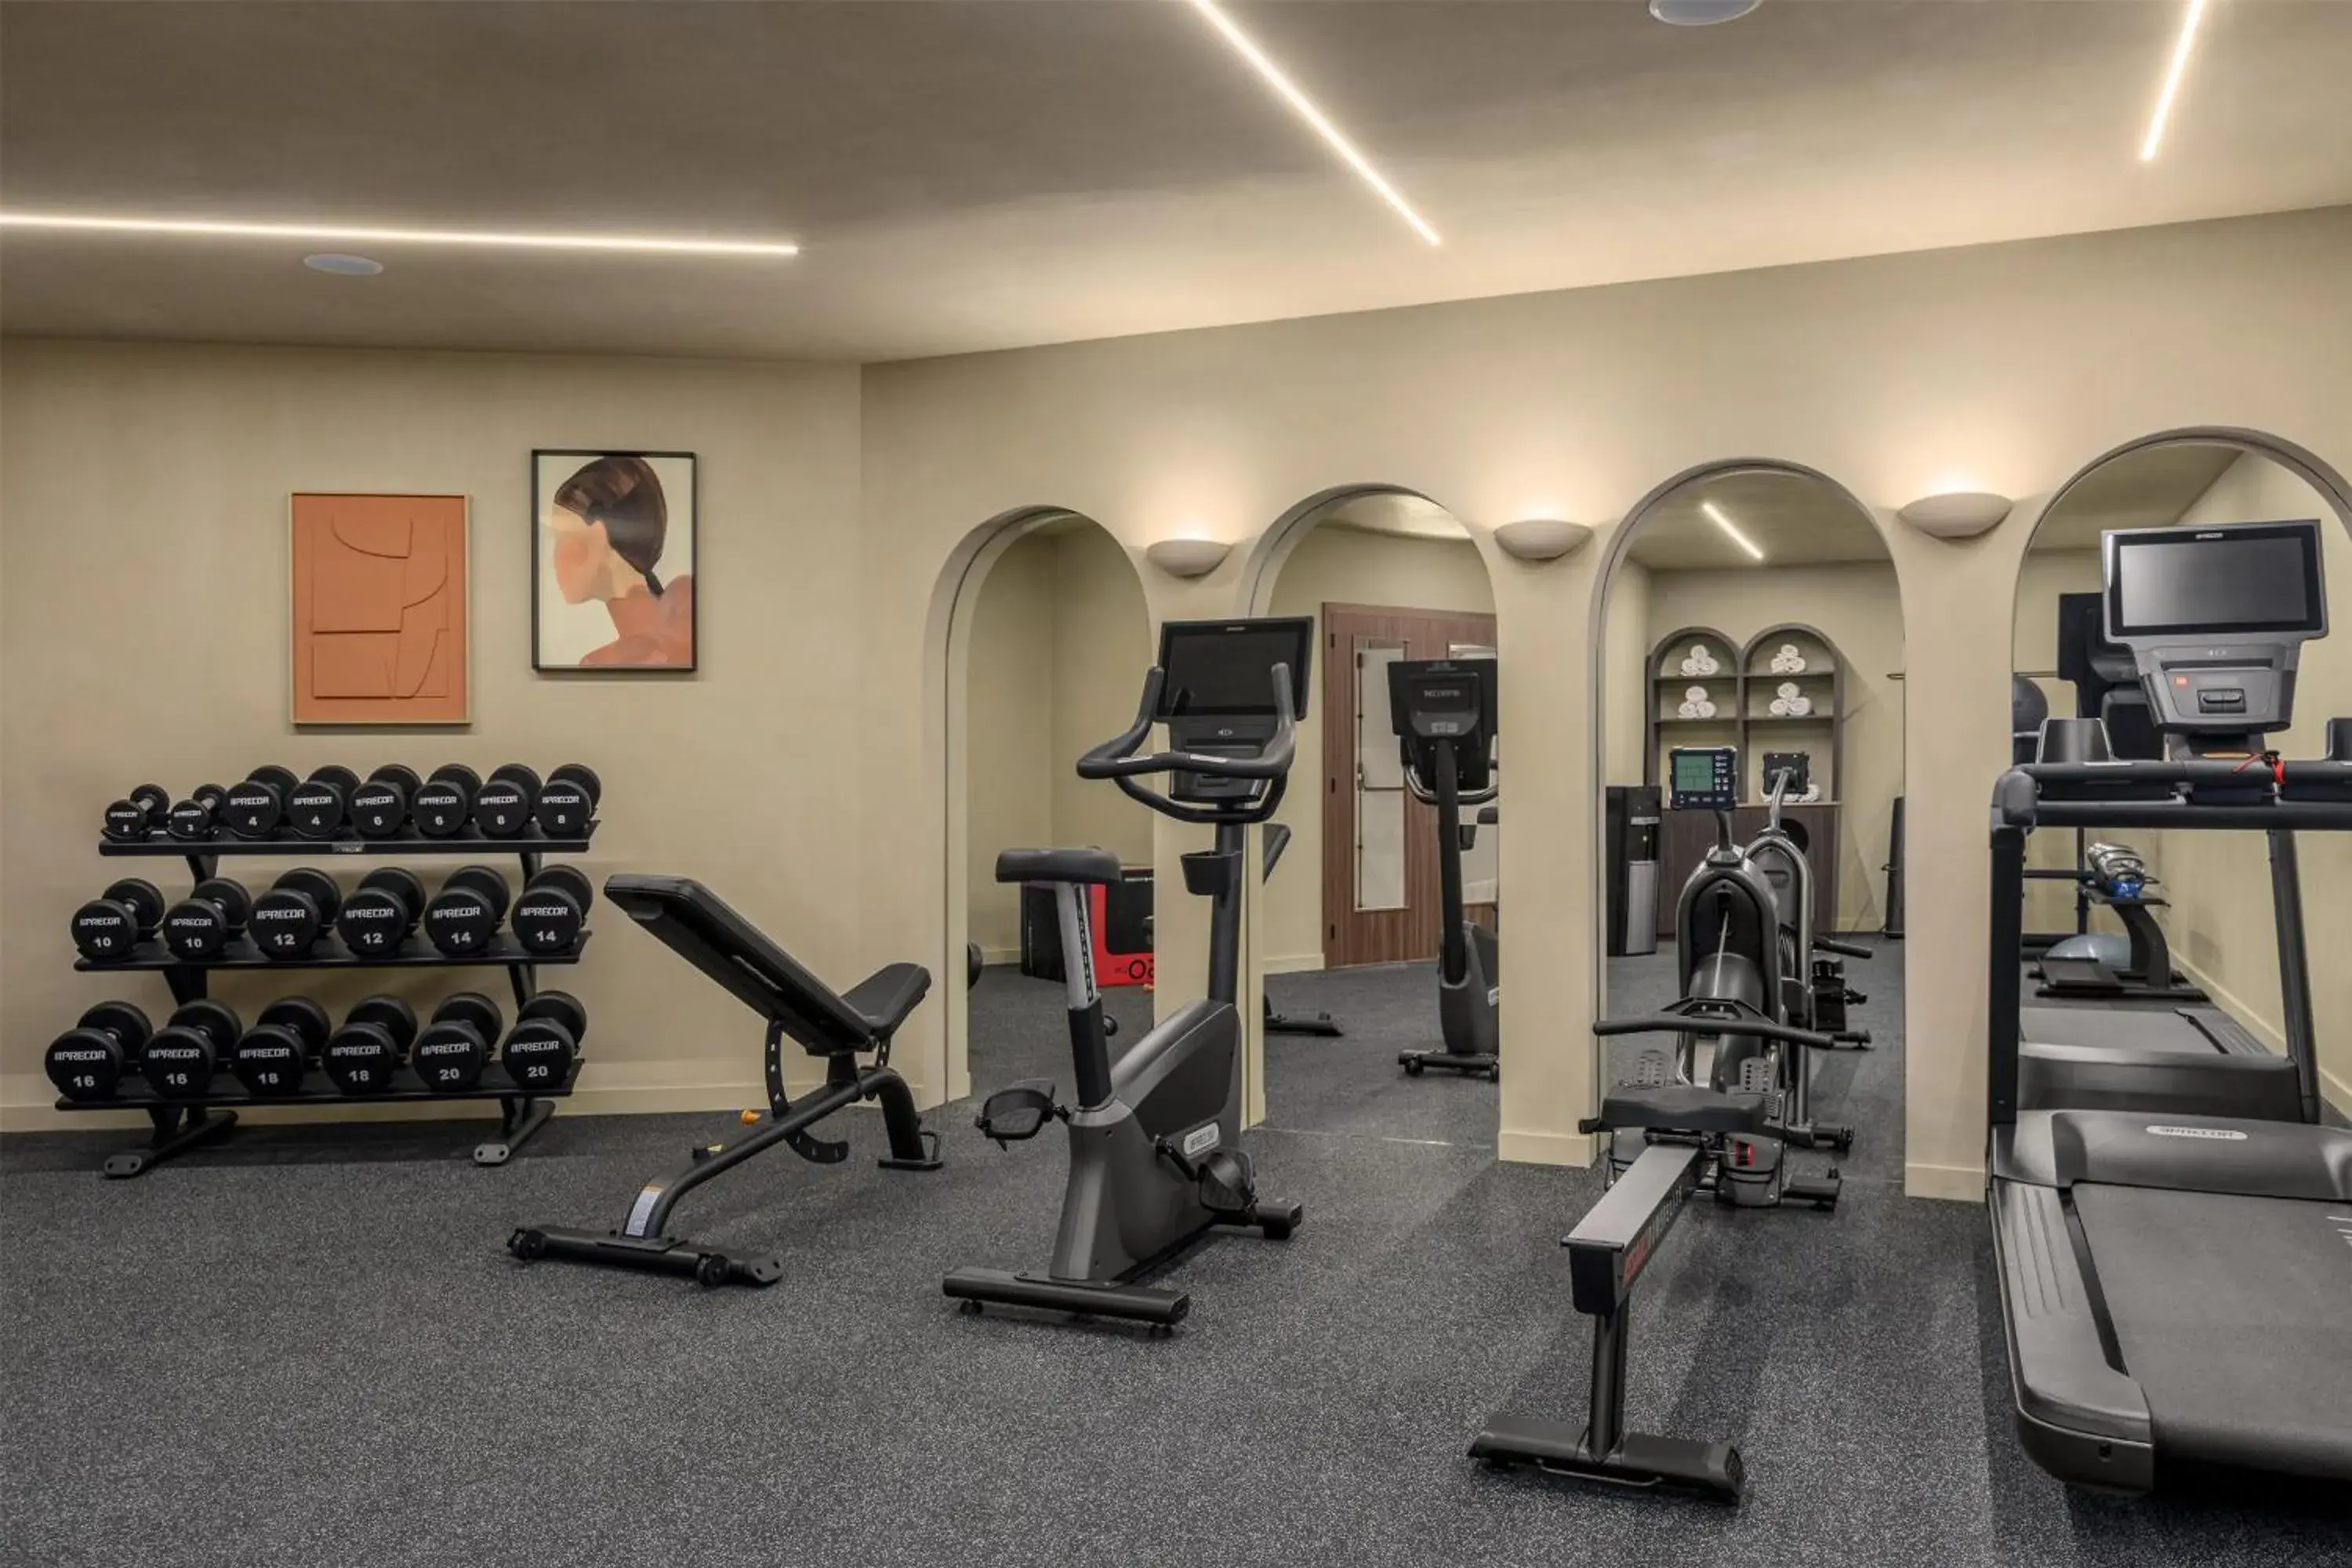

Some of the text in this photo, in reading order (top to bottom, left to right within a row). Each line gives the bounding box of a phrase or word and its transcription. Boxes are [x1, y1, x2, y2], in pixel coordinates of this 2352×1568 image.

[249, 816, 258, 826] 4
[311, 815, 321, 826] 4
[373, 815, 383, 826] 6
[434, 815, 444, 826] 6
[557, 815, 566, 824] 8
[263, 909, 306, 920] PRECOR
[352, 907, 394, 919] PRECOR
[439, 906, 481, 919] PRECOR
[526, 906, 568, 916] PRECOR
[85, 916, 121, 926] PRECOR
[176, 918, 212, 927] PRECOR
[274, 933, 296, 946] 12
[363, 932, 383, 944] 12
[451, 931, 471, 944] 14
[536, 930, 557, 942] 14
[94, 936, 112, 948] 10
[185, 938, 203, 948] 10
[339, 1045, 381, 1056] PRECOR
[428, 1042, 470, 1055] PRECOR
[517, 1040, 560, 1053] PRECOR
[61, 1050, 107, 1061] PRECOR
[155, 1048, 200, 1059] PRECOR
[246, 1047, 290, 1058] PRECOR
[349, 1069, 369, 1082] 18
[439, 1067, 460, 1080] 20
[527, 1065, 548, 1078] 20
[73, 1075, 95, 1087] 16
[166, 1073, 188, 1085] 16
[258, 1073, 279, 1084] 18
